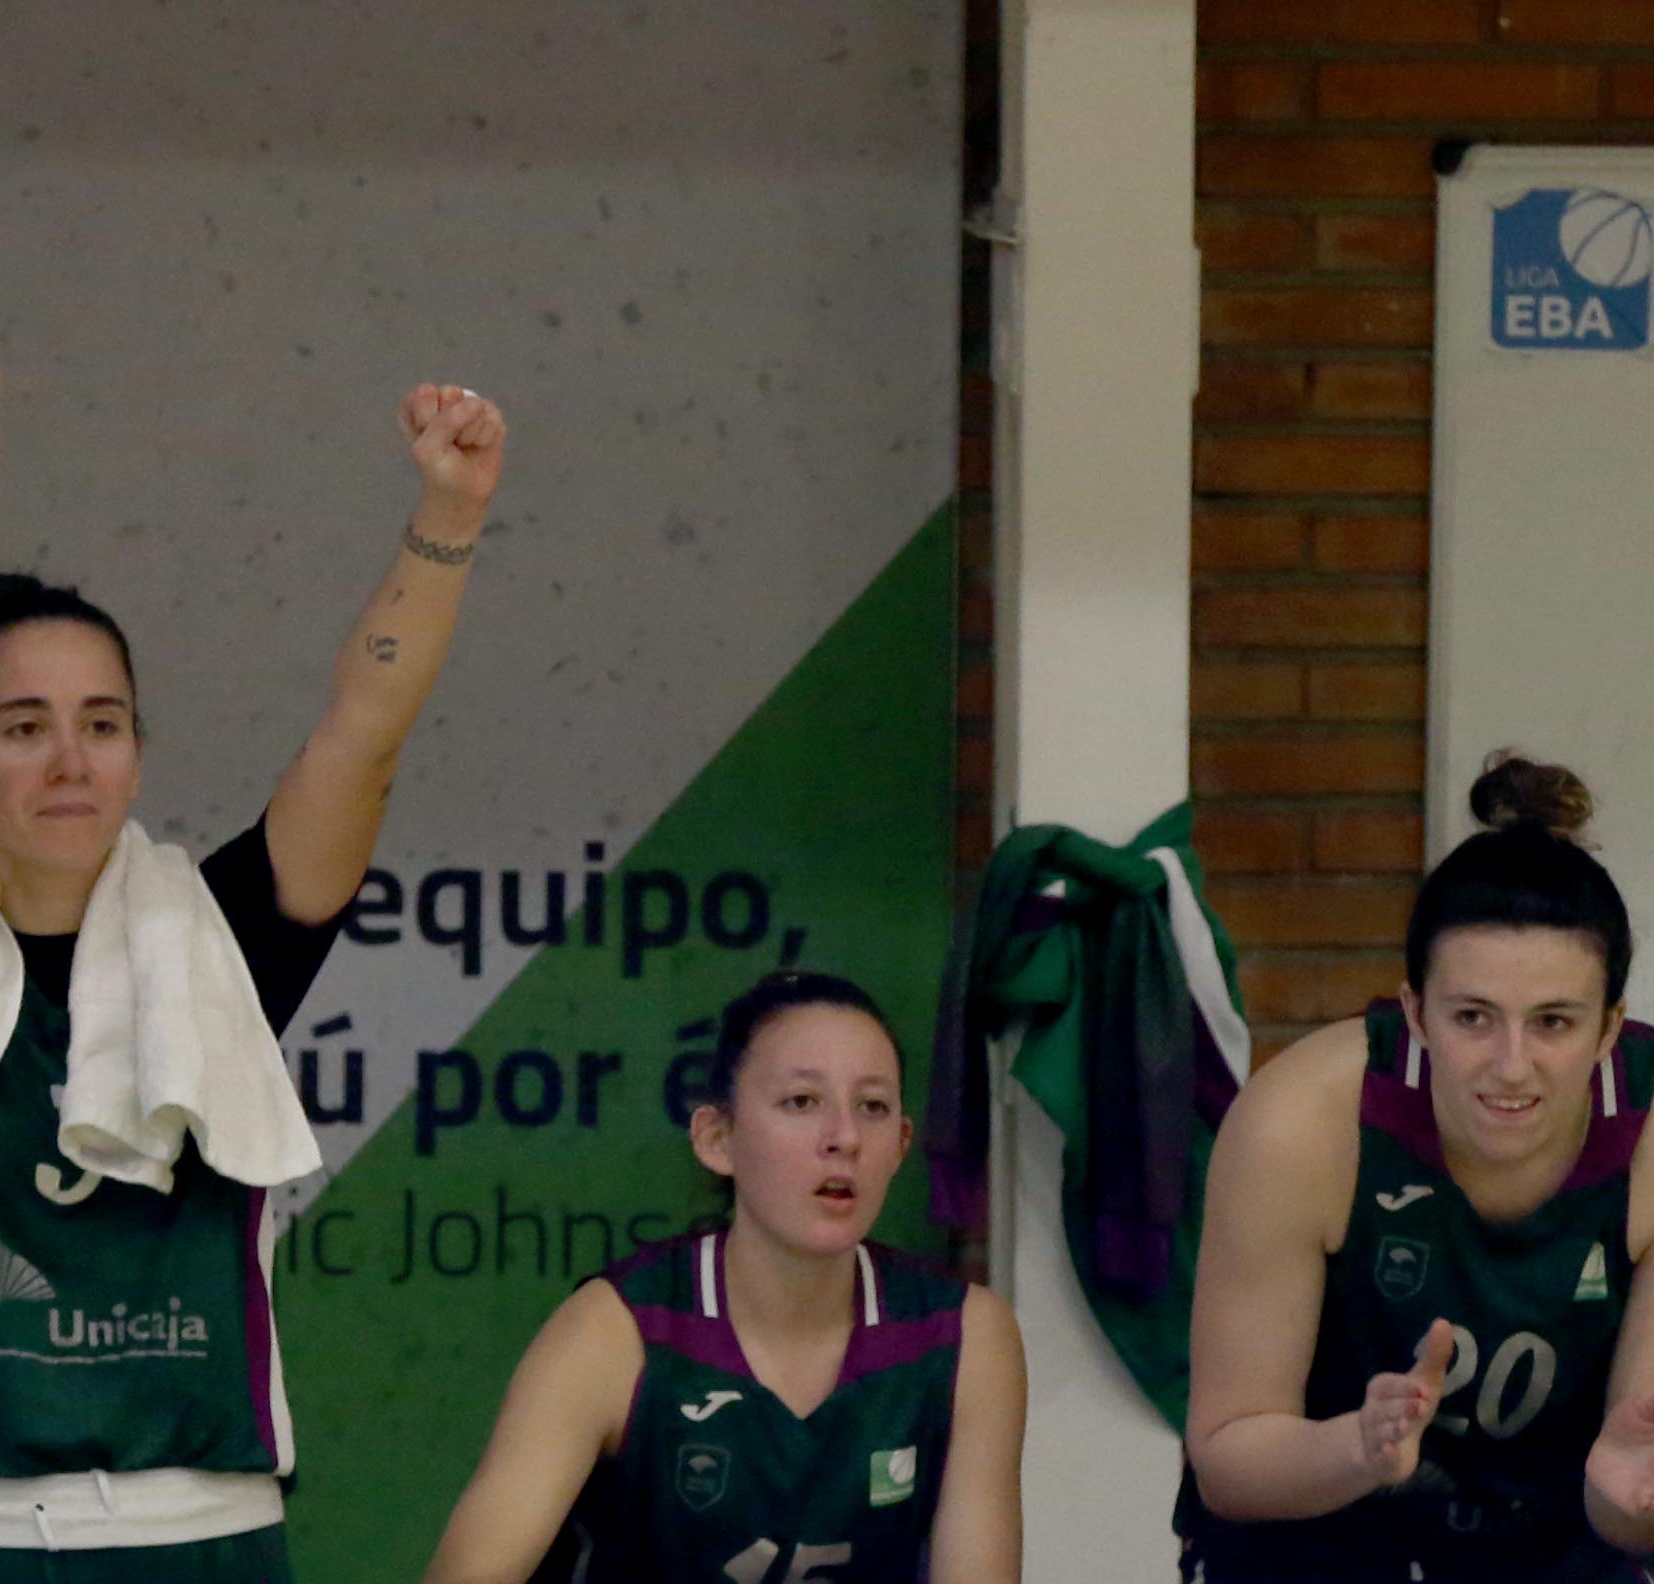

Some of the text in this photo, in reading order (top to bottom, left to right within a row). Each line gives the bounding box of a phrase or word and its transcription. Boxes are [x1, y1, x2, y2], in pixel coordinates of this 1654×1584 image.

[1504, 294, 1614, 339] EBA
[346, 842, 808, 978] equipo,
[414, 1048, 621, 1157] por
[47, 1295, 210, 1352] Unicaja
[1413, 1322, 1559, 1443] 20
